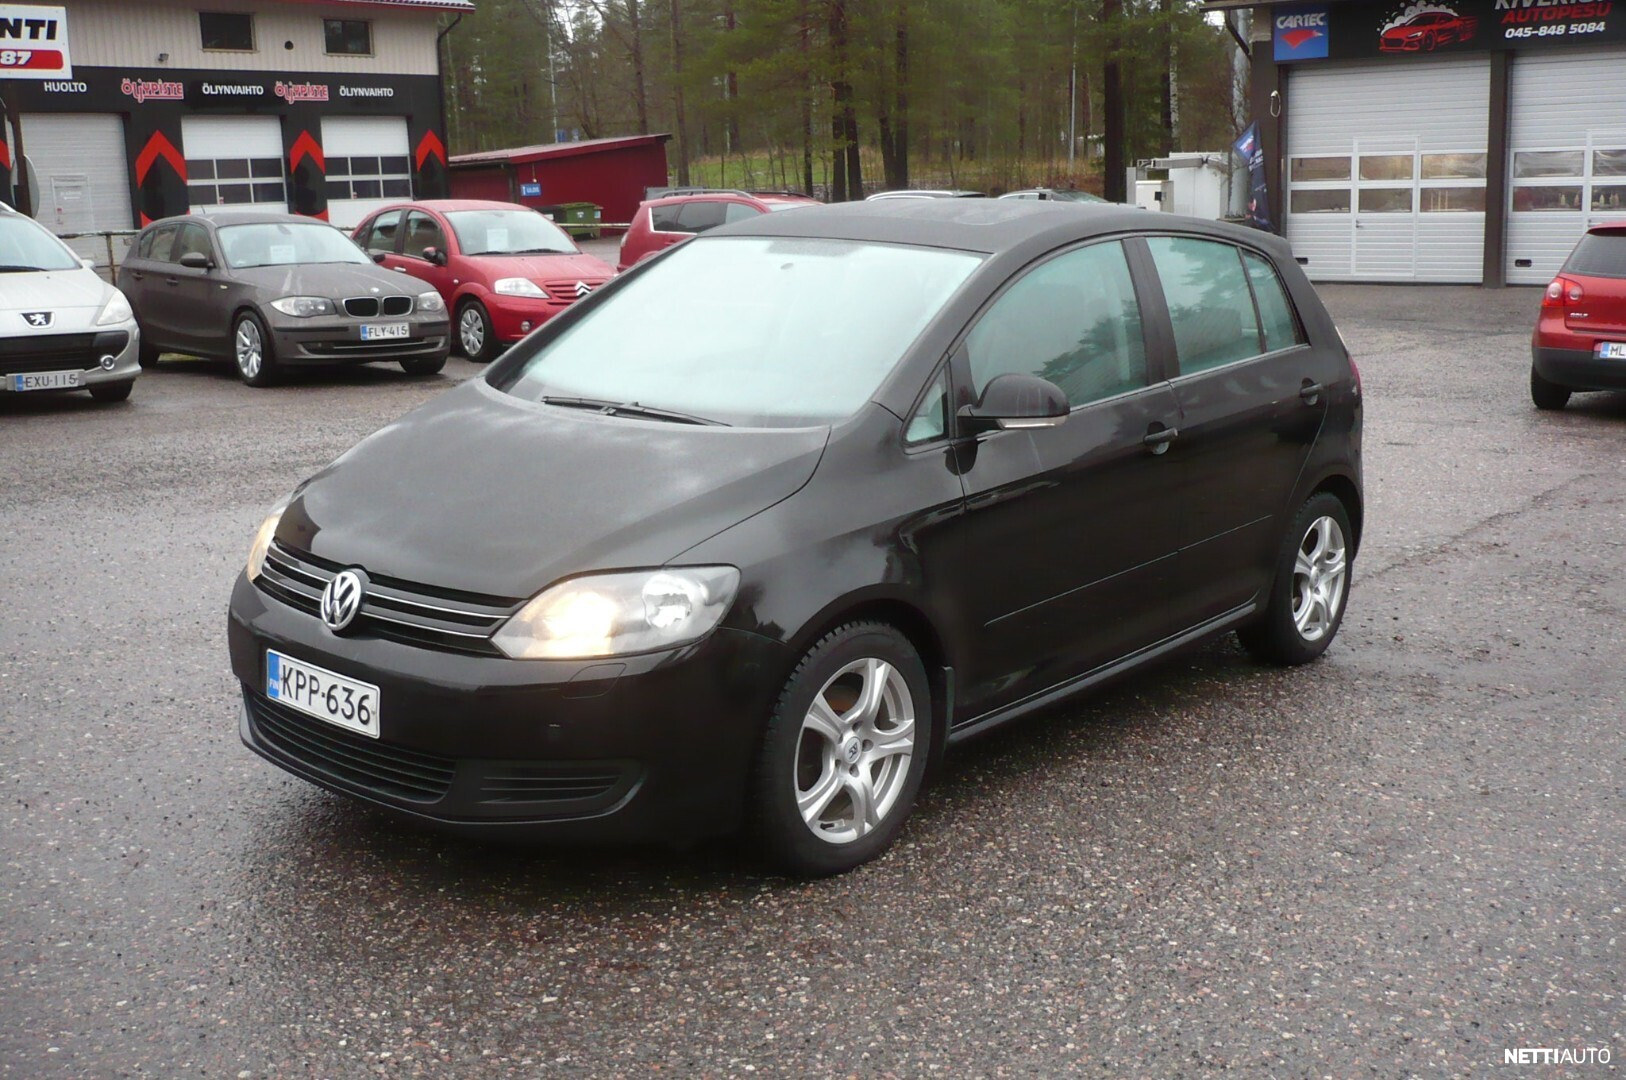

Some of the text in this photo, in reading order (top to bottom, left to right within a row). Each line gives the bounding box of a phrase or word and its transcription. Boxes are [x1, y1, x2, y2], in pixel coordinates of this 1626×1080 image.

[1276, 13, 1326, 29] CARTEC
[1501, 3, 1613, 24] AUTOPESU
[0, 18, 57, 40] NTI
[1504, 21, 1606, 38] 045-848 5084
[0, 50, 32, 65] 87
[43, 81, 87, 93] HUOLTO
[202, 82, 264, 95] ÖLJYNVAIHTO
[339, 85, 394, 97] ÖLJYNVAIHTO
[368, 325, 408, 337] FLY-415
[24, 373, 78, 388] EXU-115
[282, 664, 371, 726] KPP-636
